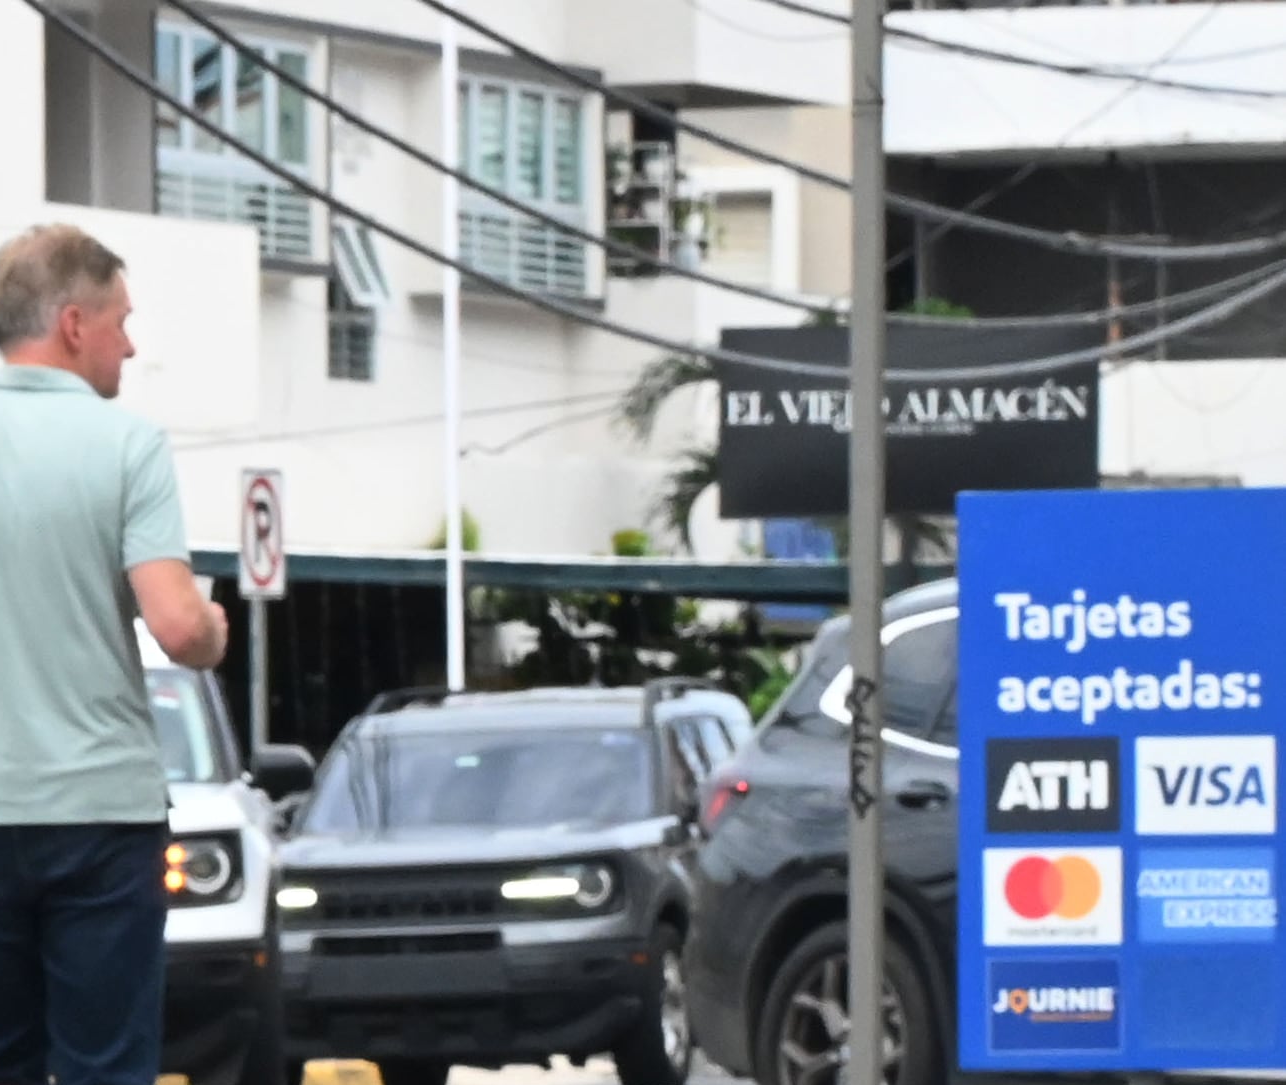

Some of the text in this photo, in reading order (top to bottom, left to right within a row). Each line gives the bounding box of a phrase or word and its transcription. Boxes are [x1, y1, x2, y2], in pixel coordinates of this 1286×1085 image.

[726, 379, 1089, 428] EL VIEJ ALMACÉN
[994, 588, 1192, 653] Tarjetas
[997, 659, 1262, 725] aceptadas:
[997, 759, 1266, 812] ATH VISA
[1138, 870, 1267, 895] AMERICAN
[992, 986, 1115, 1014] JOURNIE
